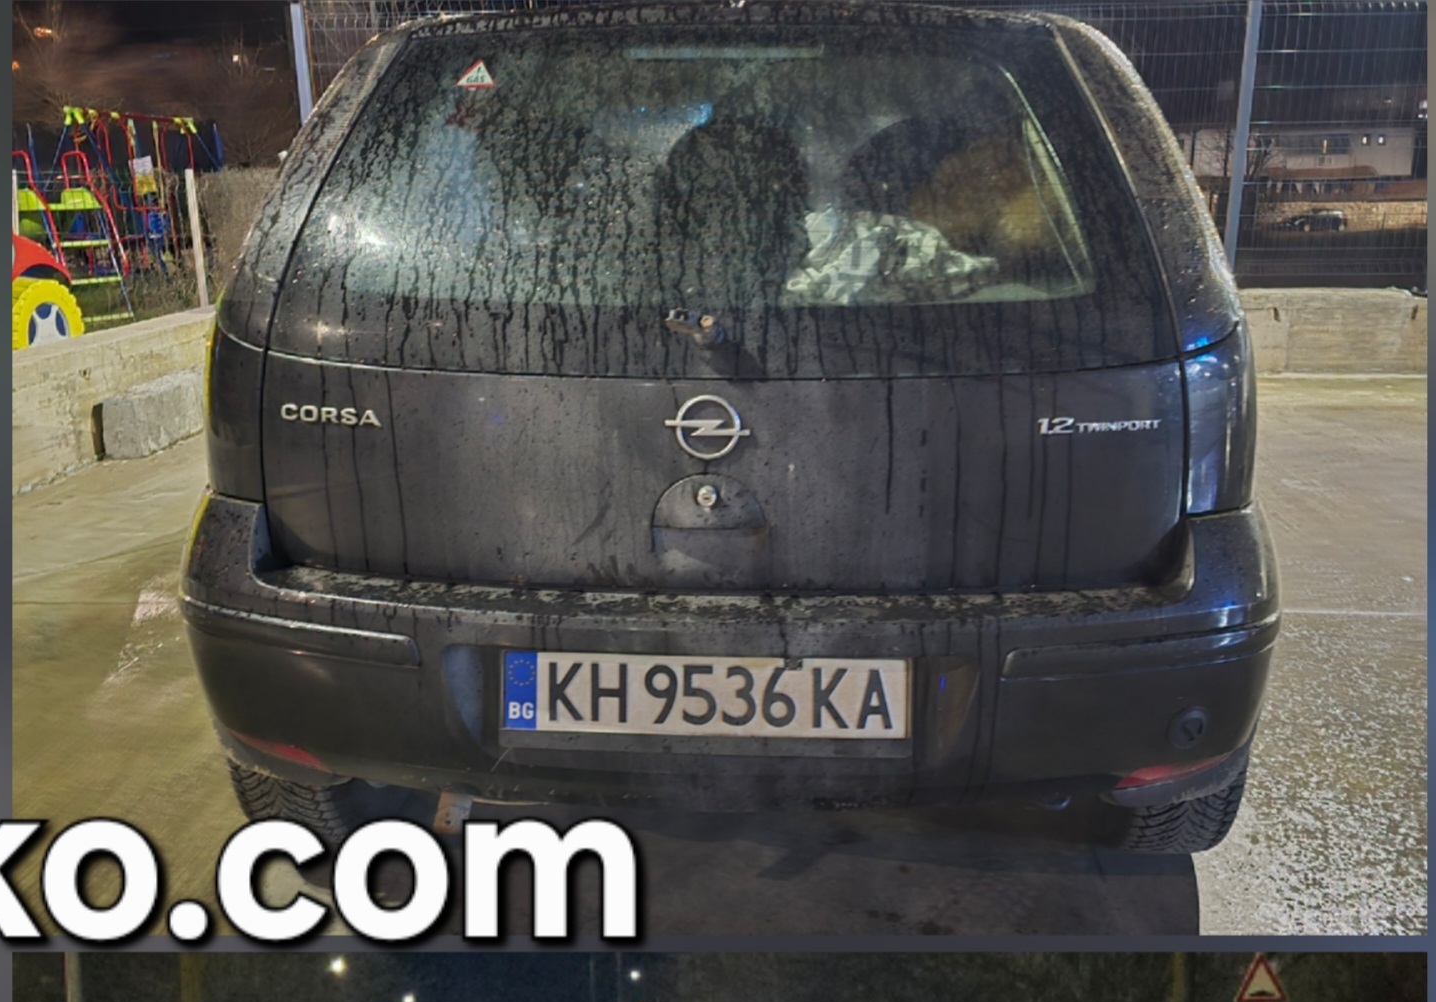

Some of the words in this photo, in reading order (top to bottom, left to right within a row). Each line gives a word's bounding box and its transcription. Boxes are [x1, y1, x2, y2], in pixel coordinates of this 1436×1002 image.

[280, 403, 382, 428] CORSA
[644, 664, 797, 728] 9536
[508, 701, 535, 720] BG
